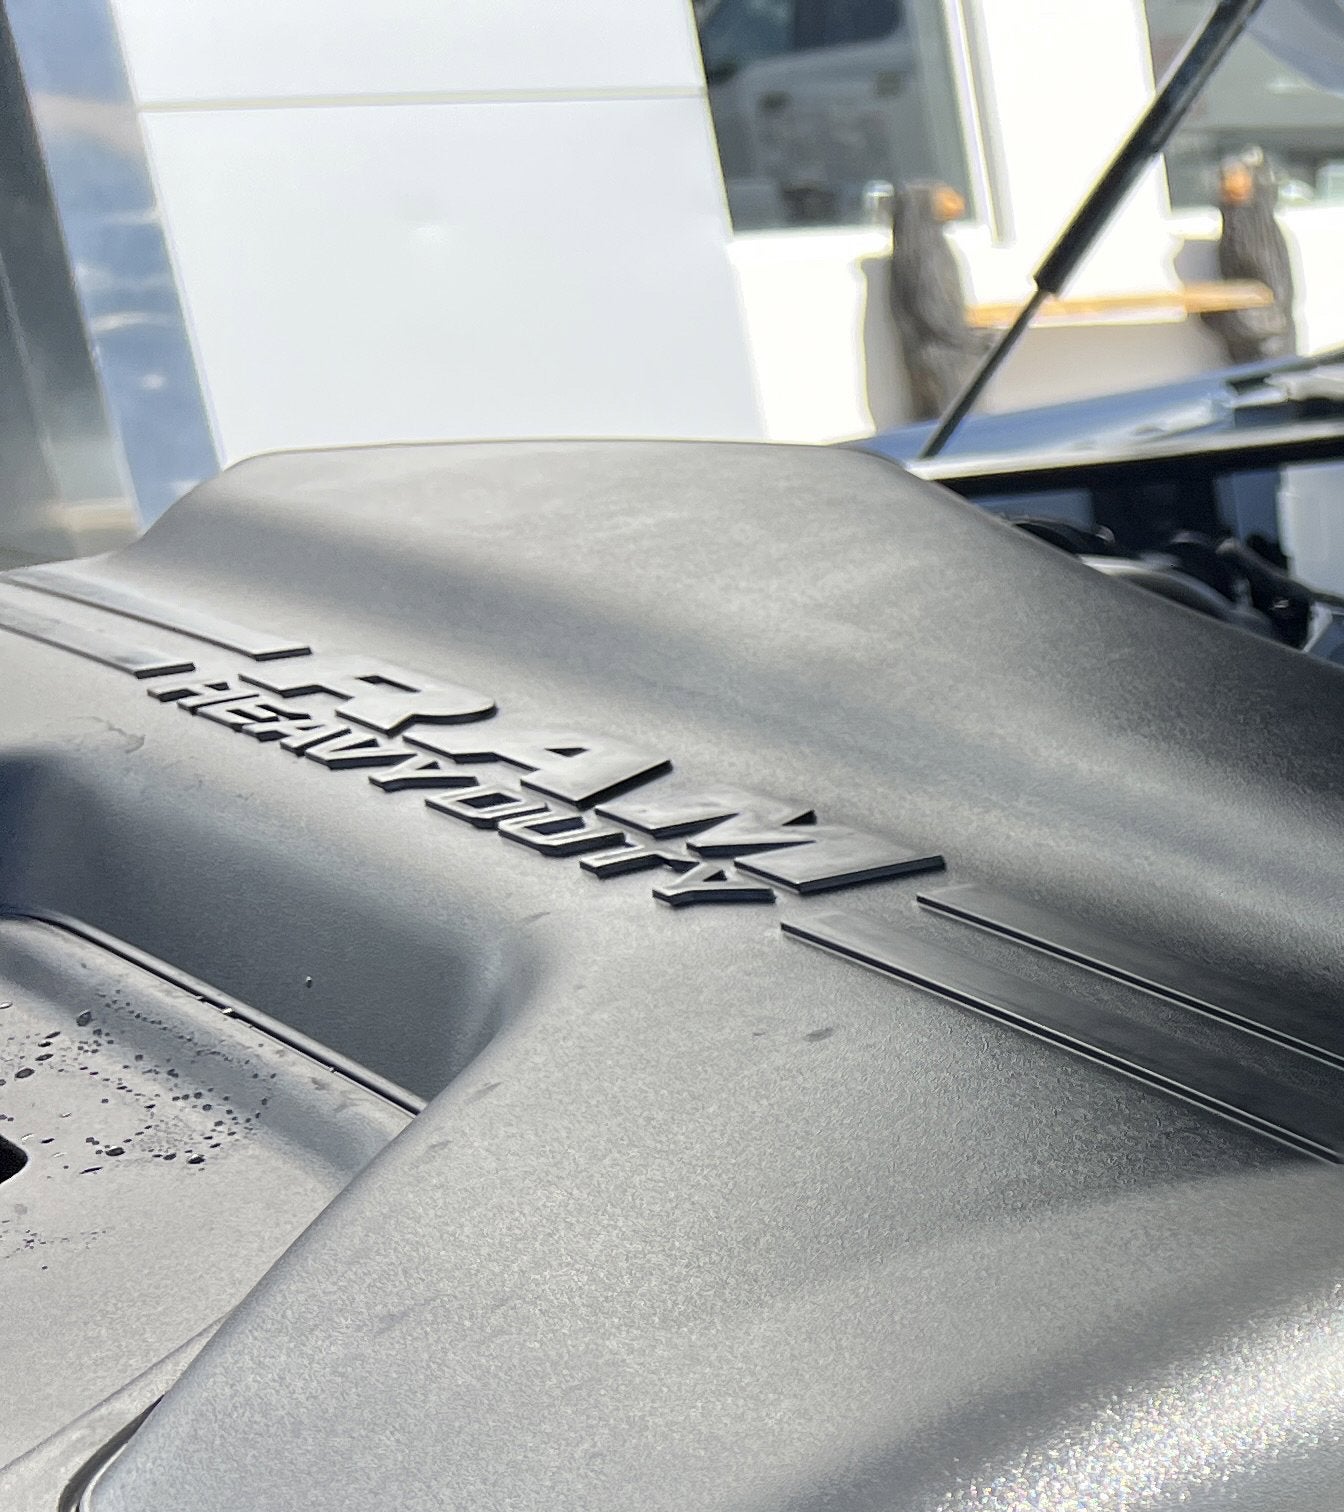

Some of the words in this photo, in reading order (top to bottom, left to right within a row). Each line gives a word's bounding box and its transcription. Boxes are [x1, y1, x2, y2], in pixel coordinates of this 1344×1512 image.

[147, 679, 480, 791] HEAVY
[424, 783, 777, 907] DUTY
[237, 656, 946, 895] RAM
